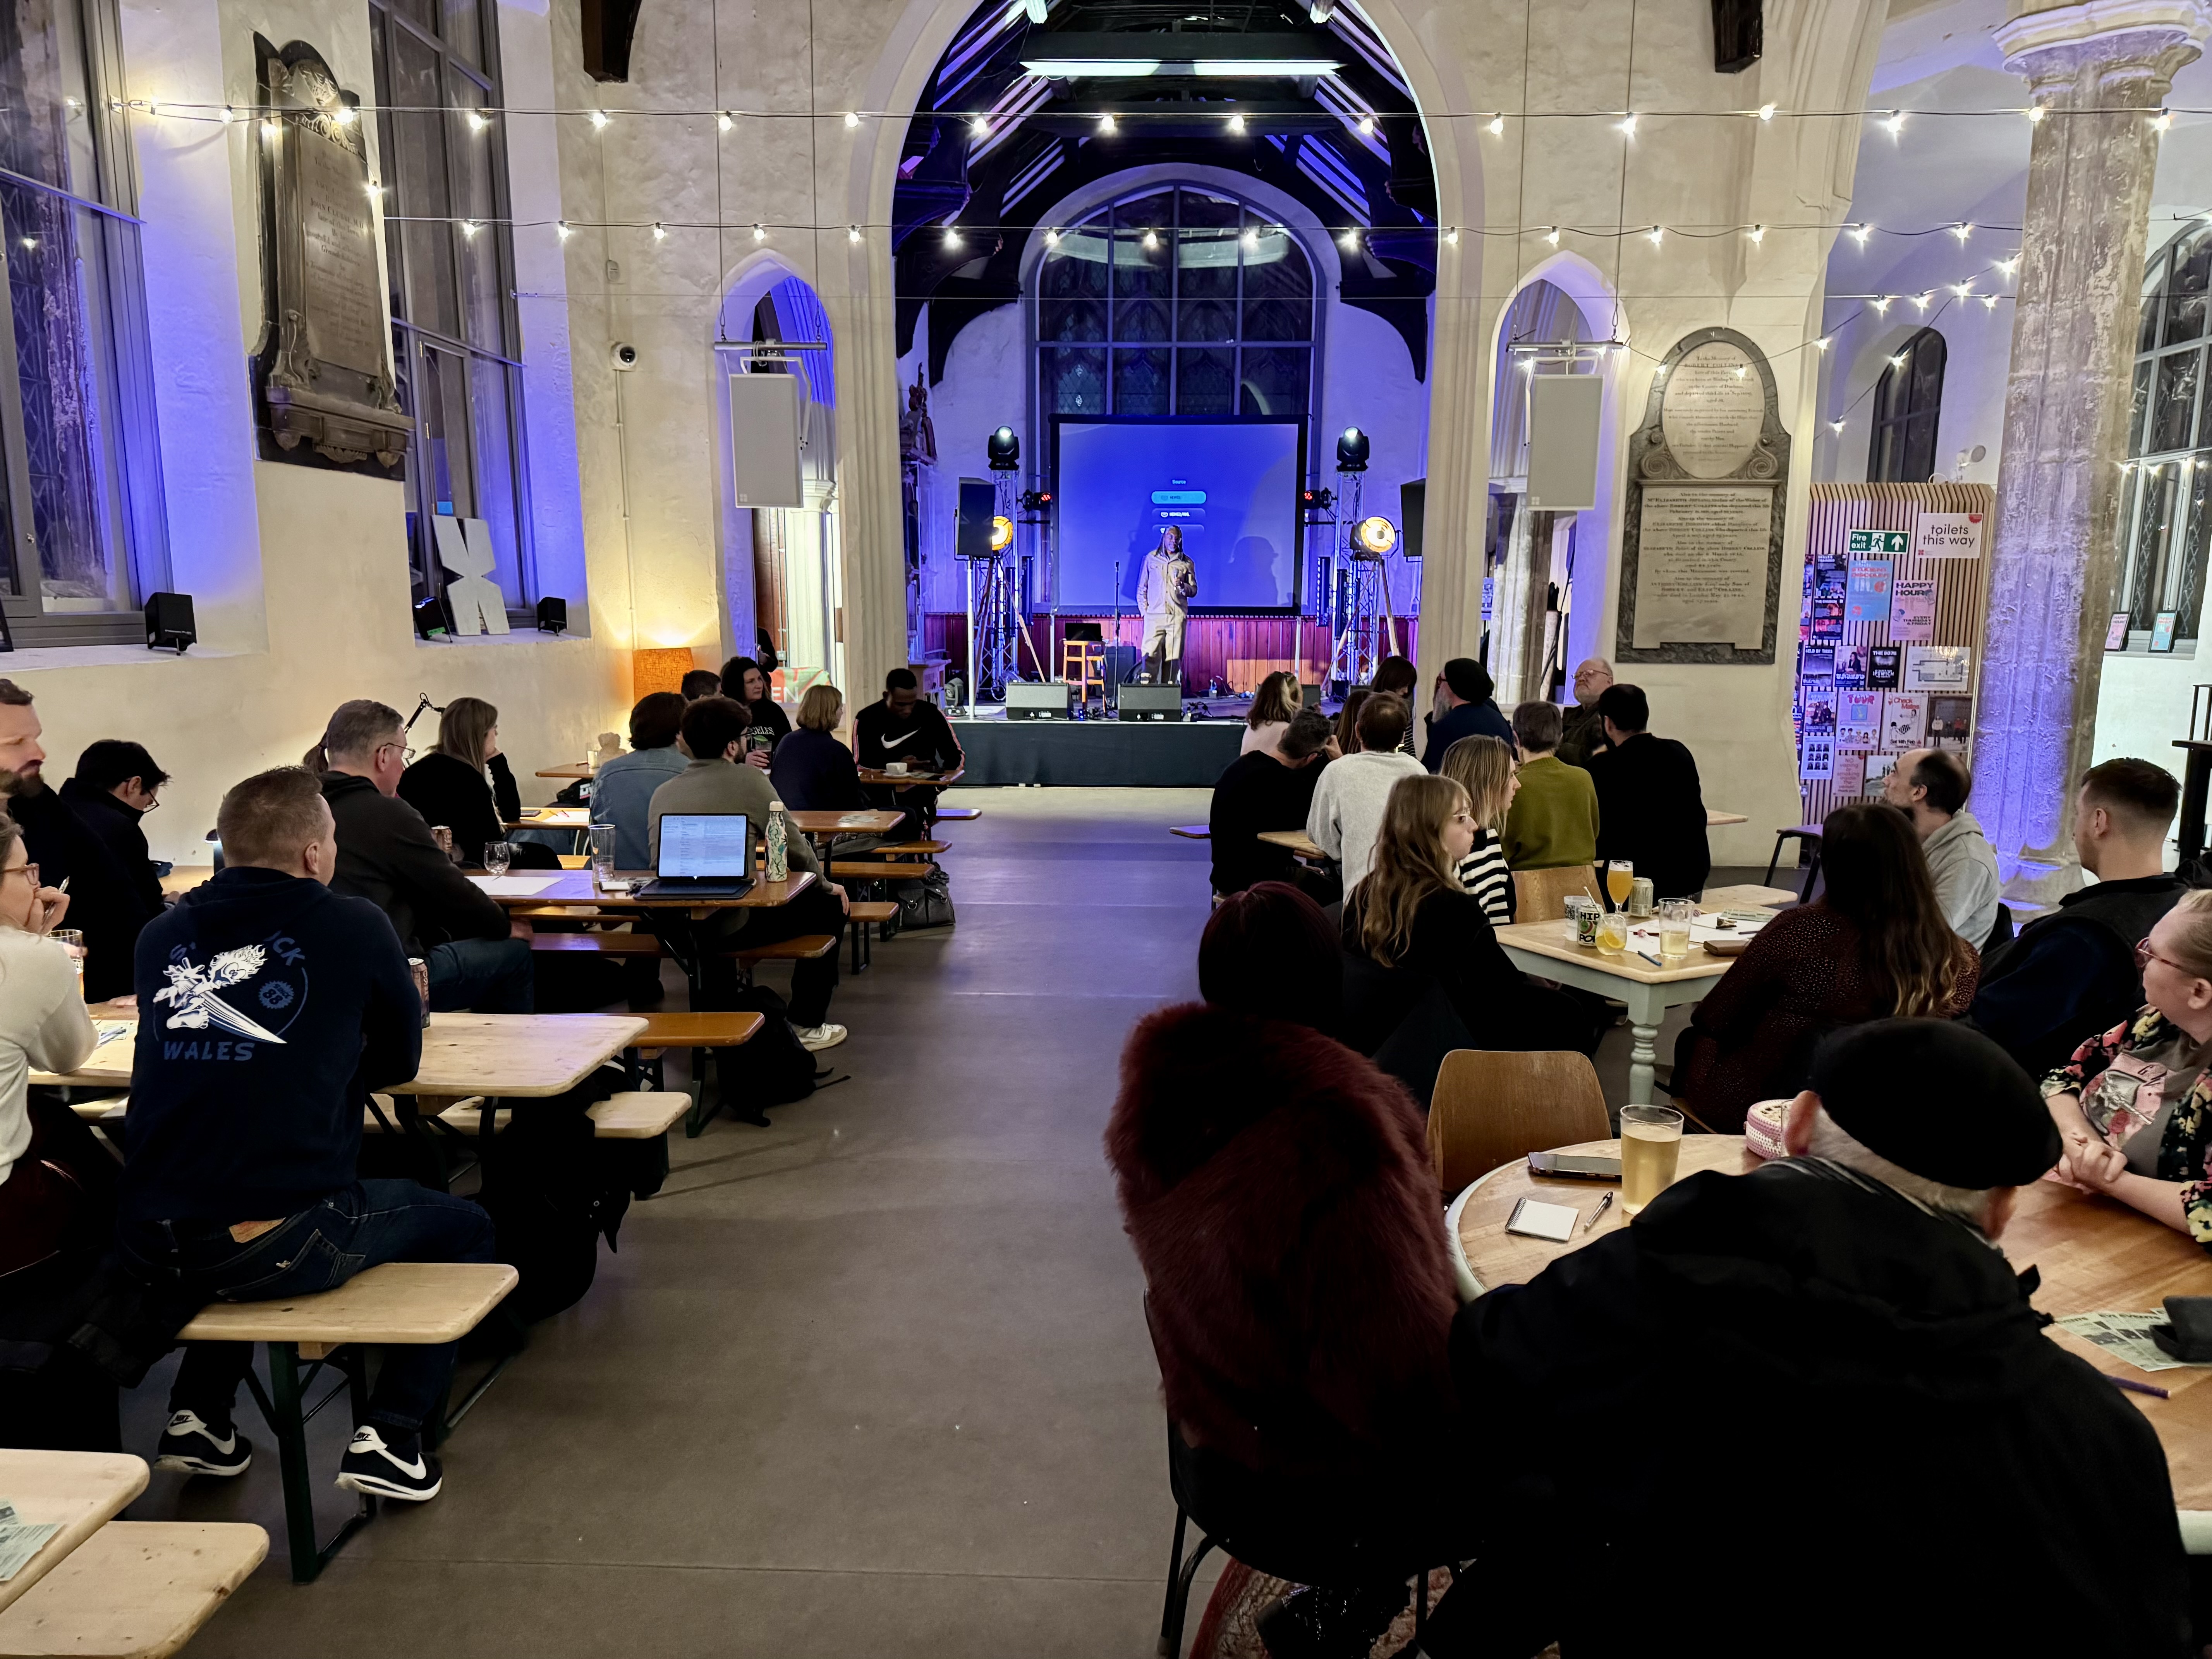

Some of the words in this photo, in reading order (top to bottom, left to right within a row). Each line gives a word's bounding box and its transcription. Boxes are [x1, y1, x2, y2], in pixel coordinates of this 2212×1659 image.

[1931, 524, 1968, 535] toilets
[1851, 541, 1866, 549] exit
[1923, 534, 1944, 545] this
[1949, 536, 1975, 548] way
[1847, 694, 1875, 704] TOUR
[752, 726, 775, 736] GELES
[1580, 912, 1600, 920] HIP
[262, 989, 283, 1005] 88
[163, 1041, 256, 1061] WALES
